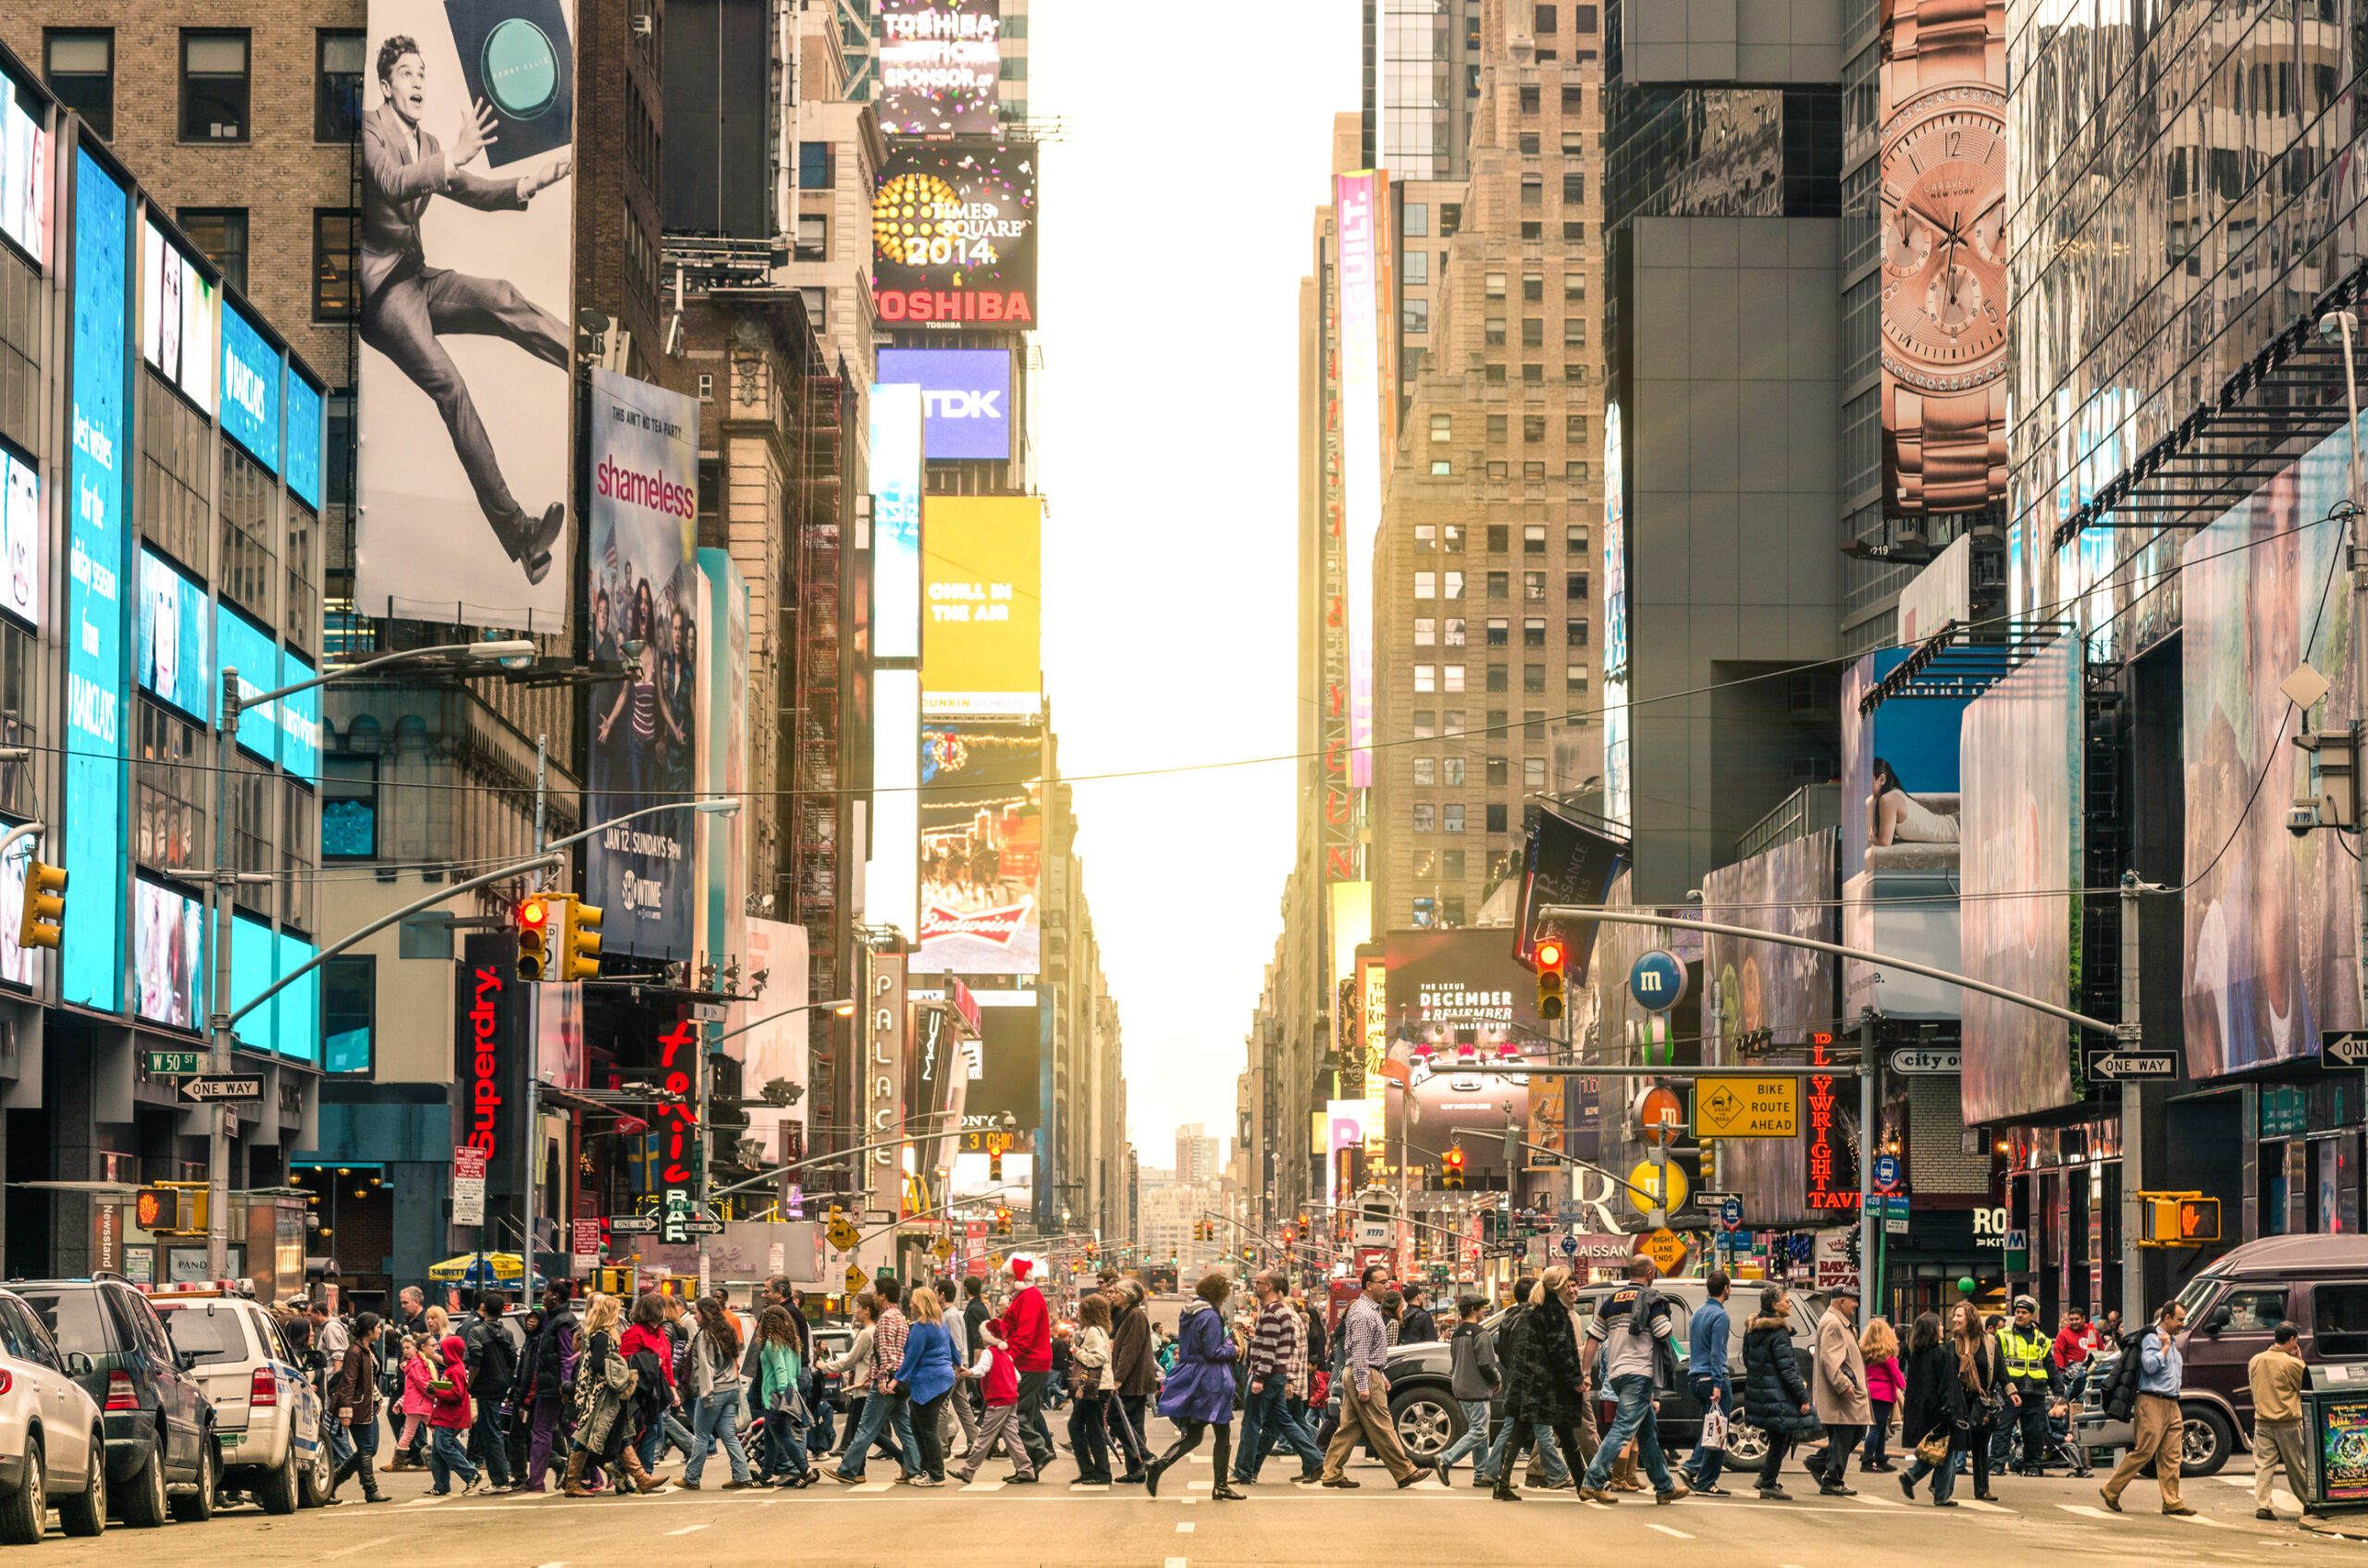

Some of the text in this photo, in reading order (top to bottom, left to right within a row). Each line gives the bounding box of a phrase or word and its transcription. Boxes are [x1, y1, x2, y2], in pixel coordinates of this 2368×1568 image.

[883, 14, 995, 34] TOSHIBA
[884, 68, 975, 87] SPONSOR
[1923, 175, 1982, 193] CARAVELLE
[1953, 188, 1975, 196] YORK
[930, 203, 992, 220] TIMES
[943, 219, 1022, 238] SQUARE
[1343, 191, 1368, 315] GUILT.
[925, 321, 962, 329] TOSHIBA
[232, 354, 265, 425] BARCLAYS
[921, 389, 1002, 418] TDK
[73, 401, 90, 454] Best
[612, 405, 682, 440] THIS AIN'T NO TEA PARTY
[597, 453, 695, 520] shameless
[70, 534, 92, 597] oliday
[928, 583, 1012, 600] CHILL IN
[931, 604, 1008, 622] THE AIR
[72, 673, 116, 745] BARCLAYS
[604, 827, 682, 860] JAN 12 SUNDAYS 9PM
[622, 869, 662, 911] SHOWTIME
[921, 912, 1026, 934] Budweiser
[1373, 982, 1386, 994] TH
[1421, 982, 1465, 991] THE LEXUS
[1640, 969, 1663, 993] m
[1420, 991, 1512, 1007] DECEMBER
[1432, 1007, 1512, 1021] REMEMBER
[153, 1055, 194, 1072] W 50 ST
[875, 974, 892, 1165] PALACE
[1904, 1052, 1942, 1070] city
[2105, 1059, 2165, 1072] ONE WAY
[192, 1081, 253, 1095] ONE WAY
[1758, 1083, 1784, 1095] BIKE
[1660, 1105, 1678, 1125] m
[1751, 1102, 1791, 1113] ROUTE
[959, 1115, 998, 1127] ONY
[1750, 1119, 1793, 1130] AHEAD
[1572, 1166, 1631, 1236] R
[1866, 1196, 1881, 1205] M20
[1972, 1206, 2006, 1234] RO
[103, 1204, 113, 1268] Newsstand
[1366, 1228, 1385, 1237] NYPD
[1652, 1236, 1674, 1244] RIGHT
[1548, 1244, 1629, 1258] RAISSAN
[1986, 1237, 2005, 1248] KIT
[1653, 1254, 1674, 1263] ENDS
[1818, 1275, 1861, 1288] PIZZA
